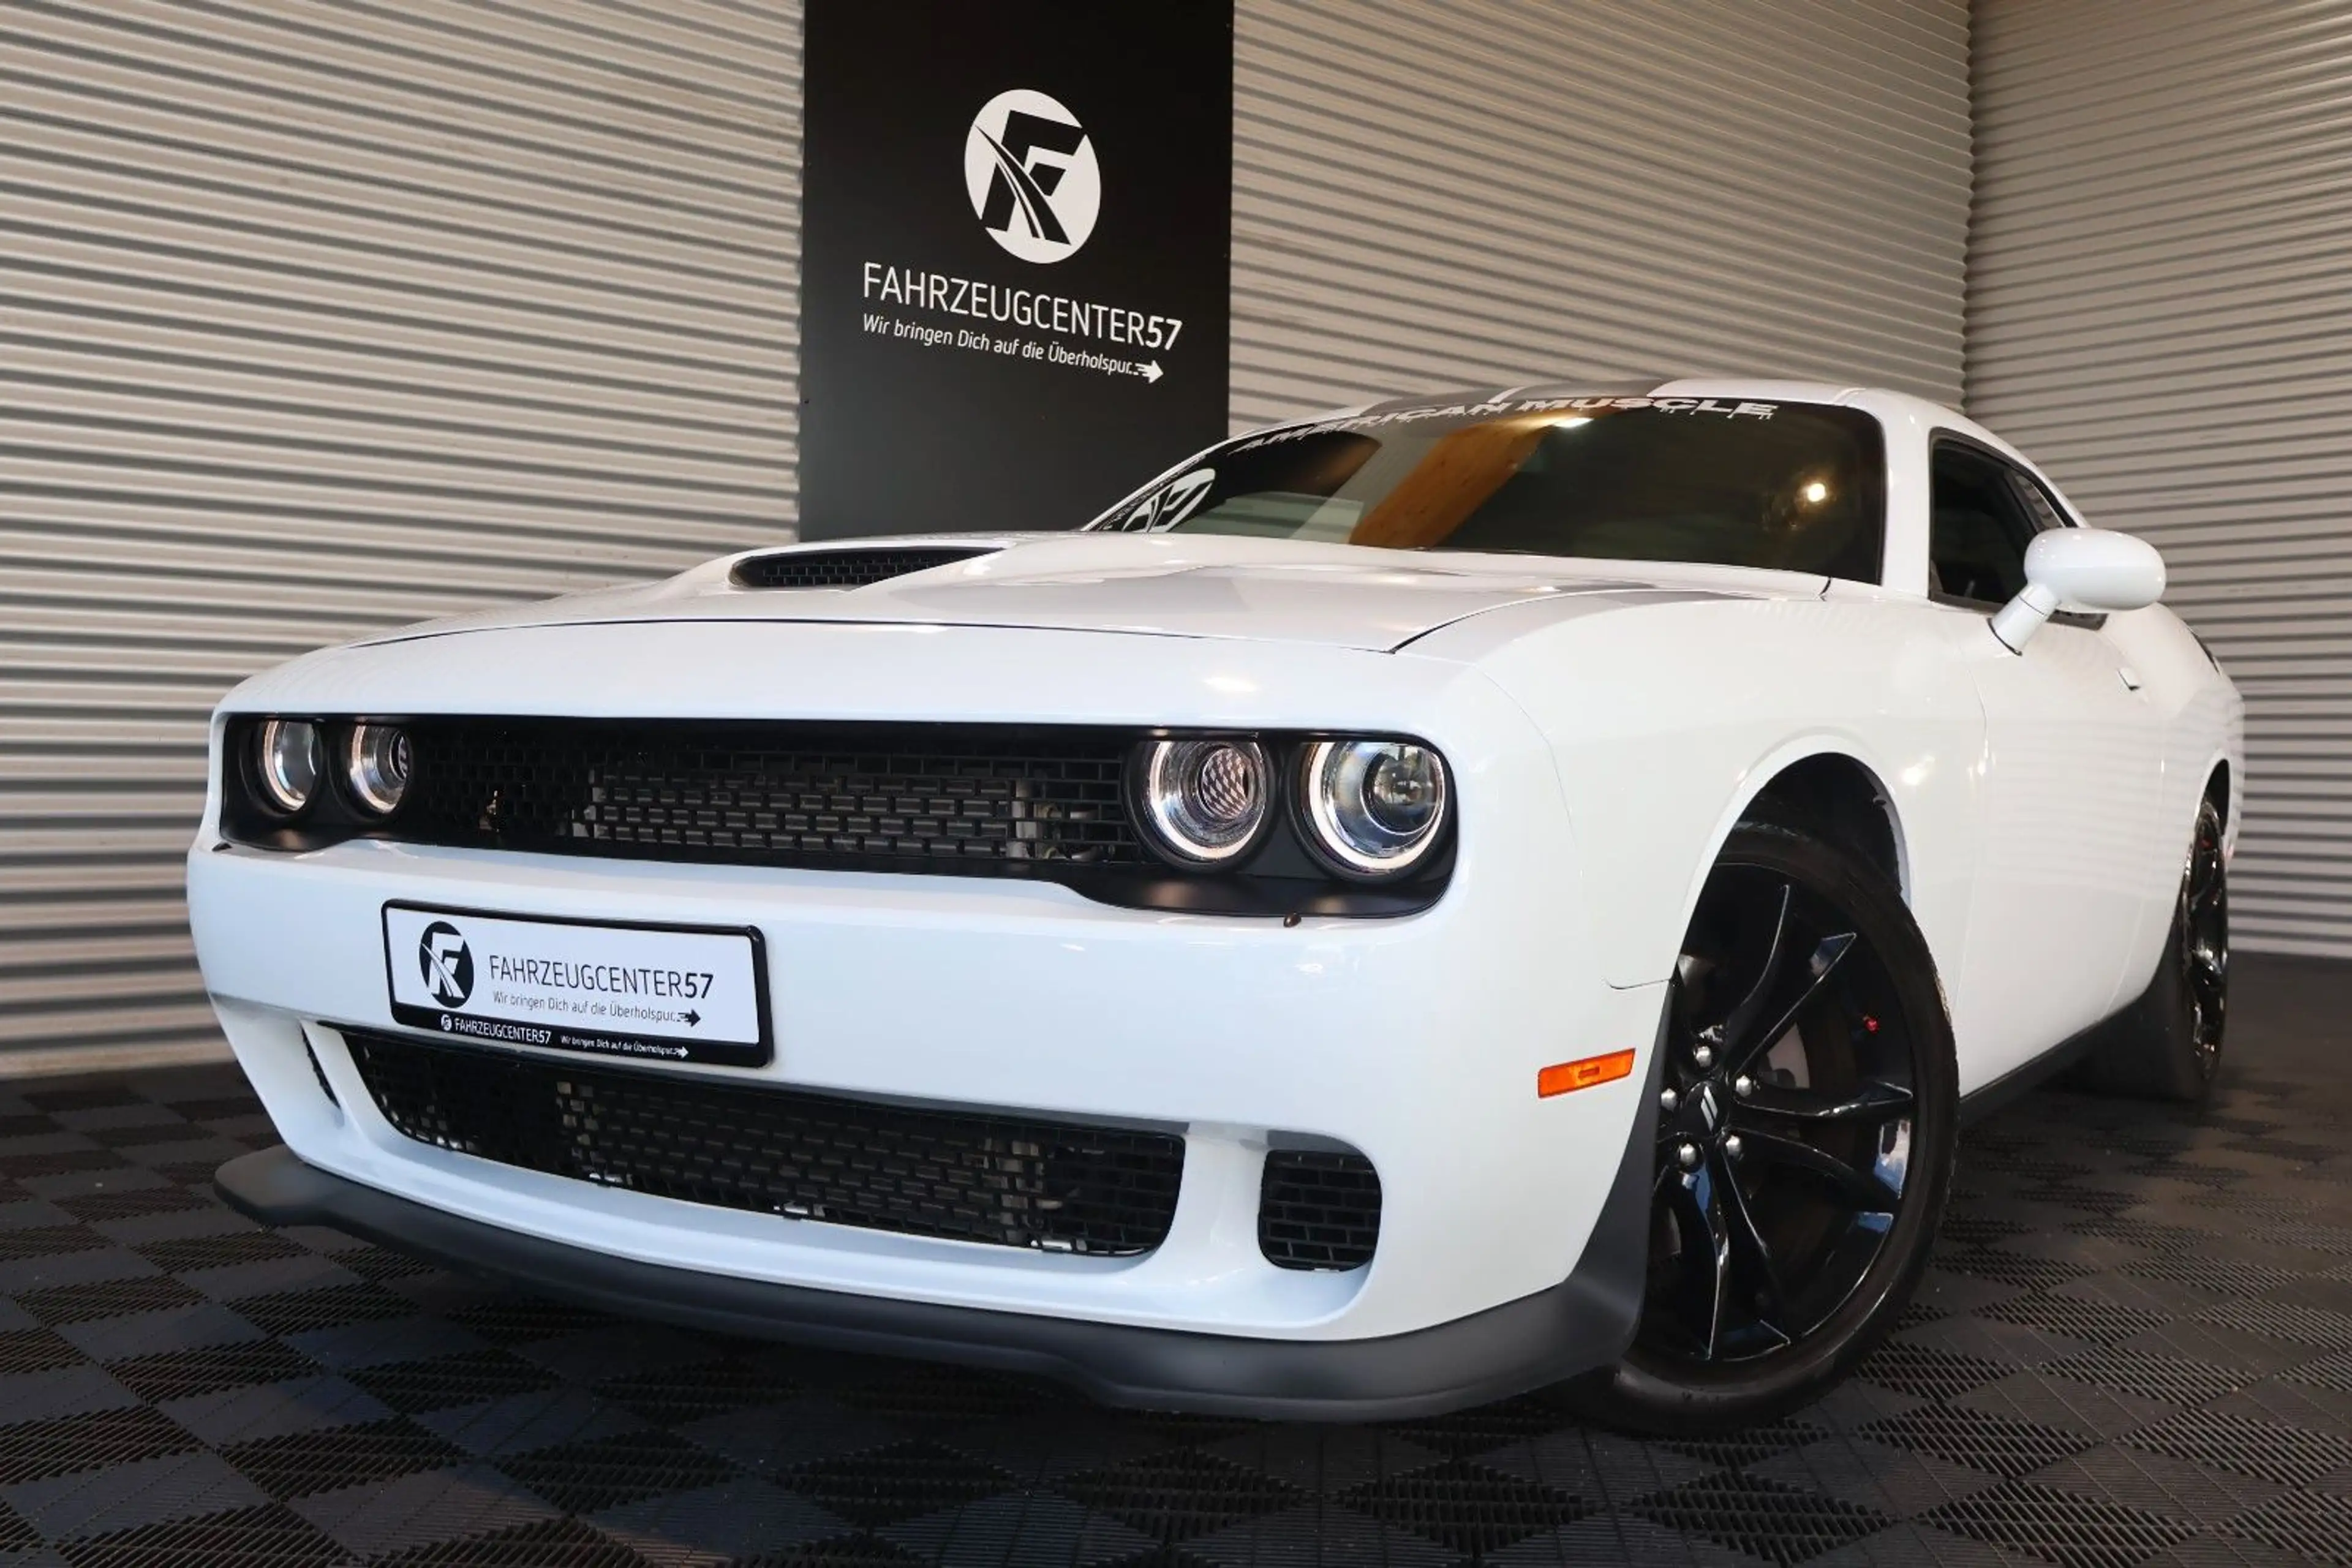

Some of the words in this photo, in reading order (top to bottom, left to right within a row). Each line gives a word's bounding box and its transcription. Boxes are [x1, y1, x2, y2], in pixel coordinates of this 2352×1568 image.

[864, 262, 1183, 351] FAHRZEUGCENTER57
[863, 313, 890, 334] Wir
[894, 319, 952, 347] bringen
[957, 329, 990, 351] Dich
[993, 338, 1020, 355] auf
[1022, 341, 1044, 360] die
[1517, 398, 1779, 420] MUSCLE
[489, 954, 714, 1000] FAHRZEUGCENTER57
[492, 990, 508, 1005] Wir
[510, 995, 545, 1011] bringen
[548, 998, 568, 1012] Dich
[571, 1000, 588, 1013] auf
[590, 1001, 606, 1016] die
[454, 1017, 552, 1044] FAHRZEUGCENTER57
